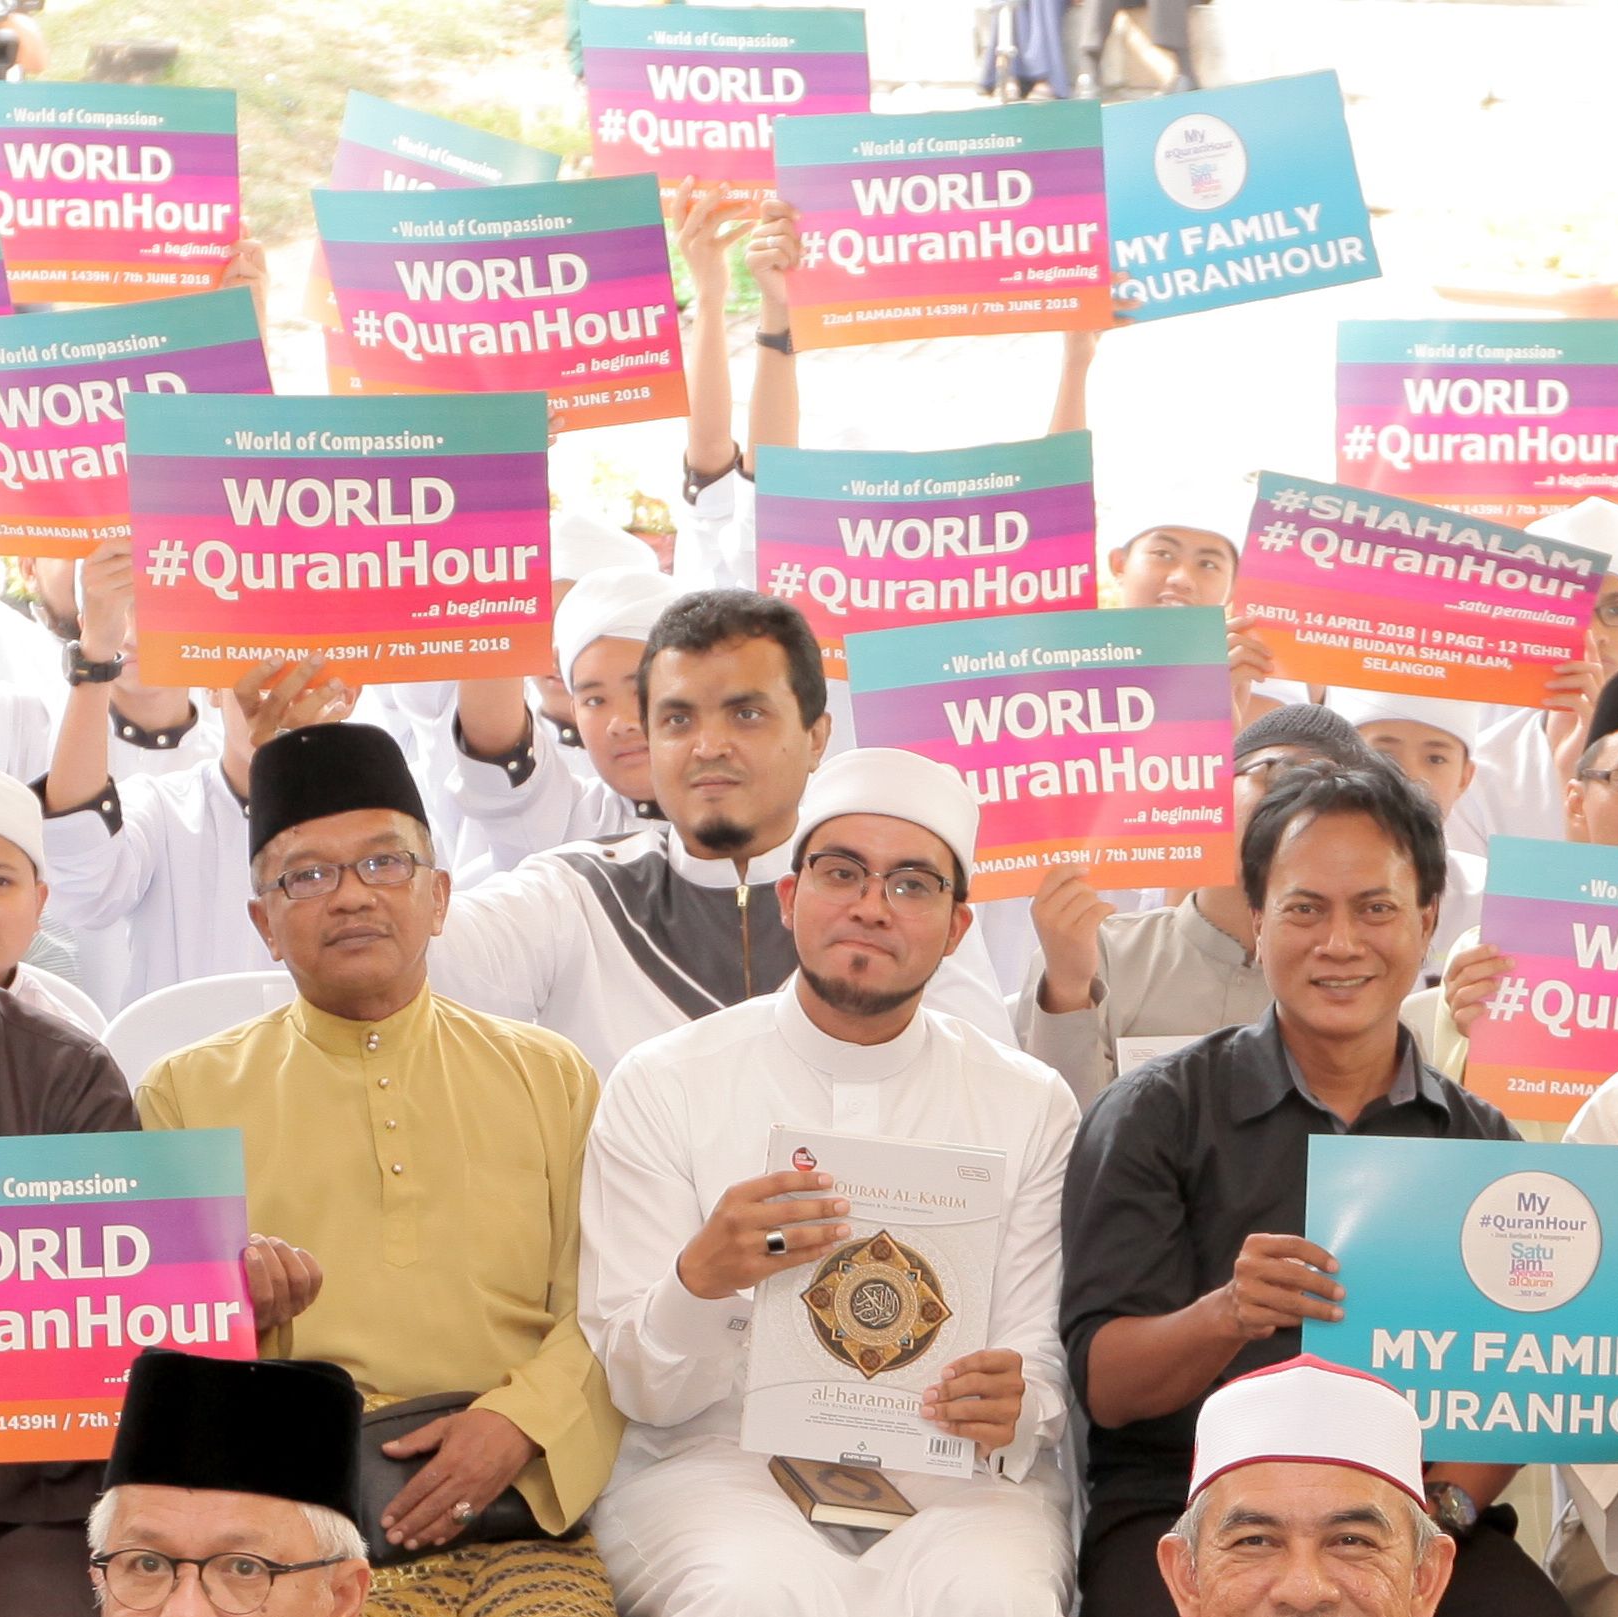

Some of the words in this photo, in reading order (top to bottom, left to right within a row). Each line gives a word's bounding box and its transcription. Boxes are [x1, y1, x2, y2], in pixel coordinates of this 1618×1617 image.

[647, 64, 804, 104] WORLD
[3, 141, 173, 183] WORLD
[852, 169, 1033, 217] WORLD
[800, 220, 1098, 274] #QuranHour
[1114, 232, 1170, 268] MY
[1179, 203, 1322, 256] FAMILY
[394, 252, 588, 302] WORLD
[352, 302, 666, 361] #QuranHour
[1403, 378, 1570, 417] WORLD
[235, 431, 291, 451] World
[296, 430, 316, 450] of
[320, 432, 434, 454] Compassion
[222, 477, 456, 527] WORLD
[838, 511, 1029, 559] WORLD
[1270, 487, 1592, 576] #SHAHALAM
[146, 539, 538, 601] #QuranHour
[1258, 520, 1586, 600] #QuranHour
[446, 596, 536, 618] beginning
[767, 562, 1089, 614] #QuranHour
[387, 641, 417, 657] 7th
[420, 638, 465, 655] JUNE
[469, 636, 511, 653] 2018
[1362, 656, 1446, 679] SELANGOR
[943, 685, 1155, 746] WORLD
[3, 1174, 128, 1202] Compassion
[1517, 1192, 1551, 1215] My
[1479, 1214, 1587, 1231] #QuranHour
[1511, 1242, 1554, 1260] Satu
[1372, 1328, 1459, 1370] MY
[78, 1412, 108, 1428] 7th
